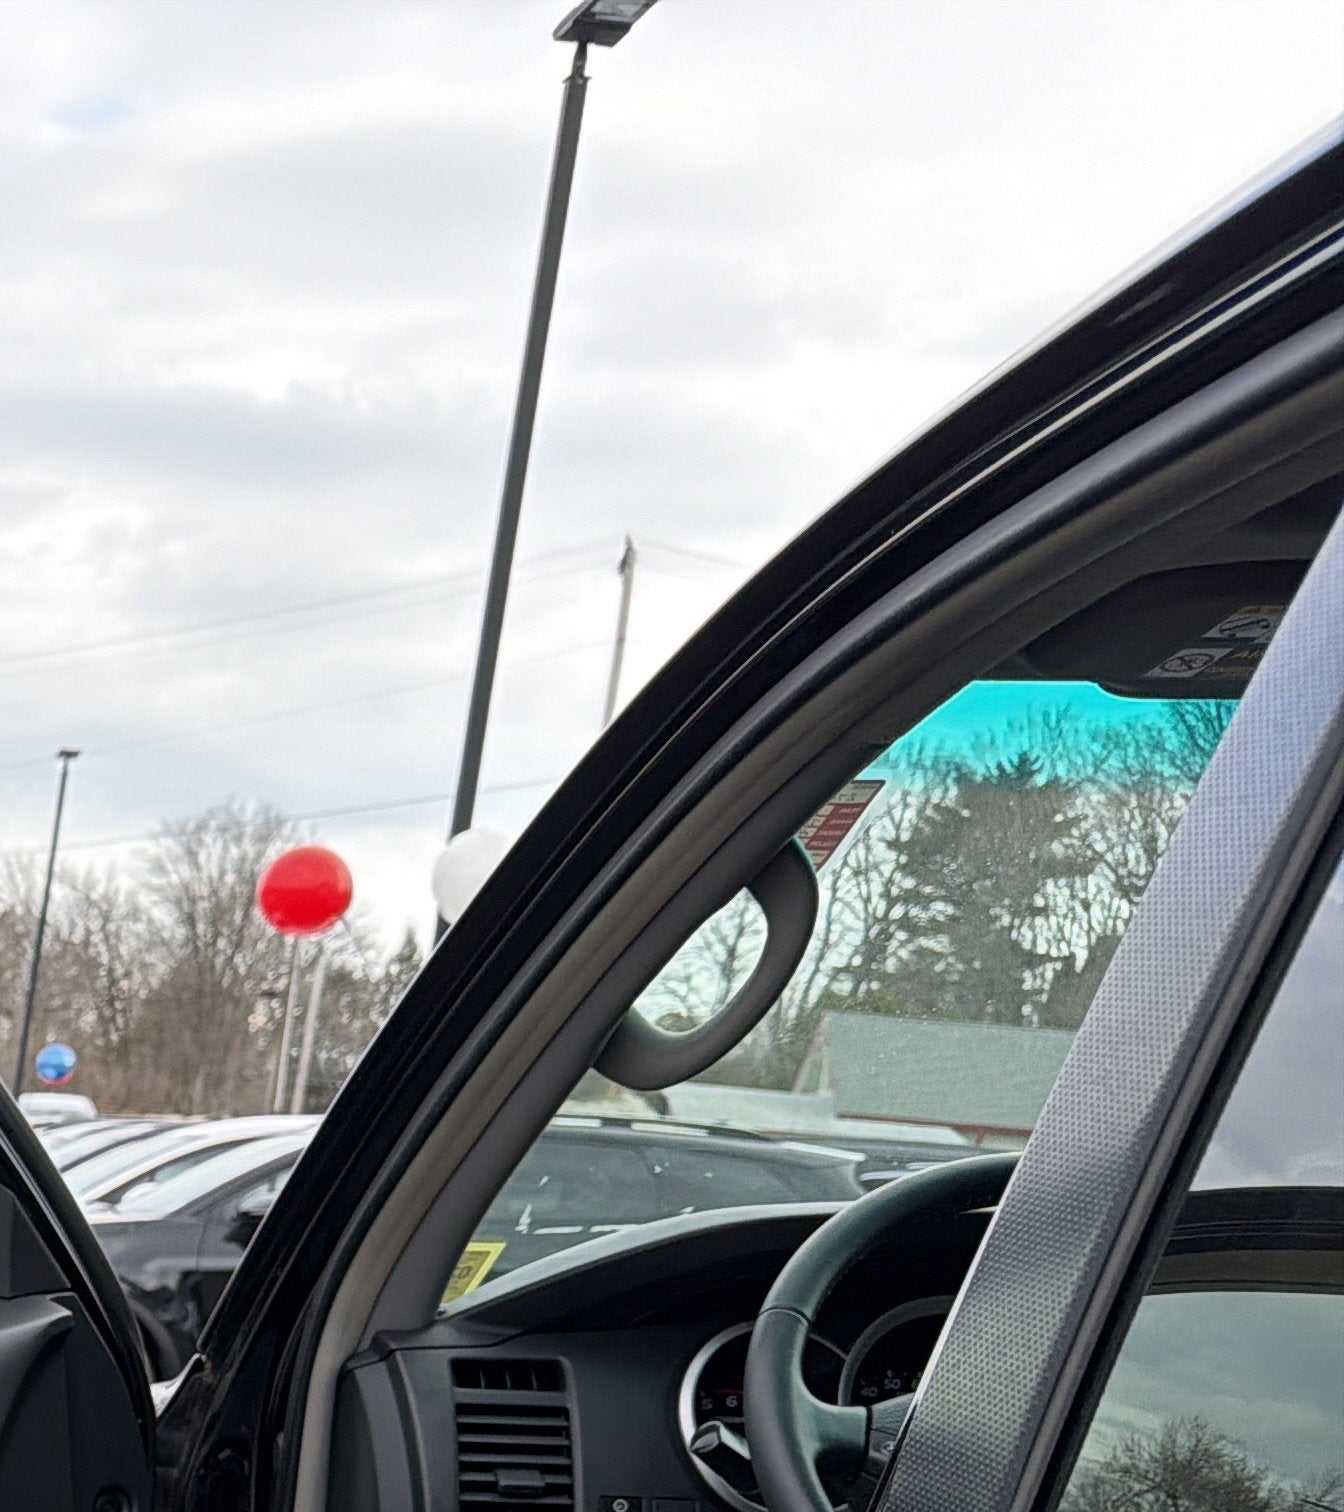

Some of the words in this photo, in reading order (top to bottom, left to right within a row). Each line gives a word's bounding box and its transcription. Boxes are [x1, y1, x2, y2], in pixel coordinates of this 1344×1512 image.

[883, 1378, 902, 1390] 50
[701, 1397, 714, 1410] 5
[725, 1395, 739, 1408] 6
